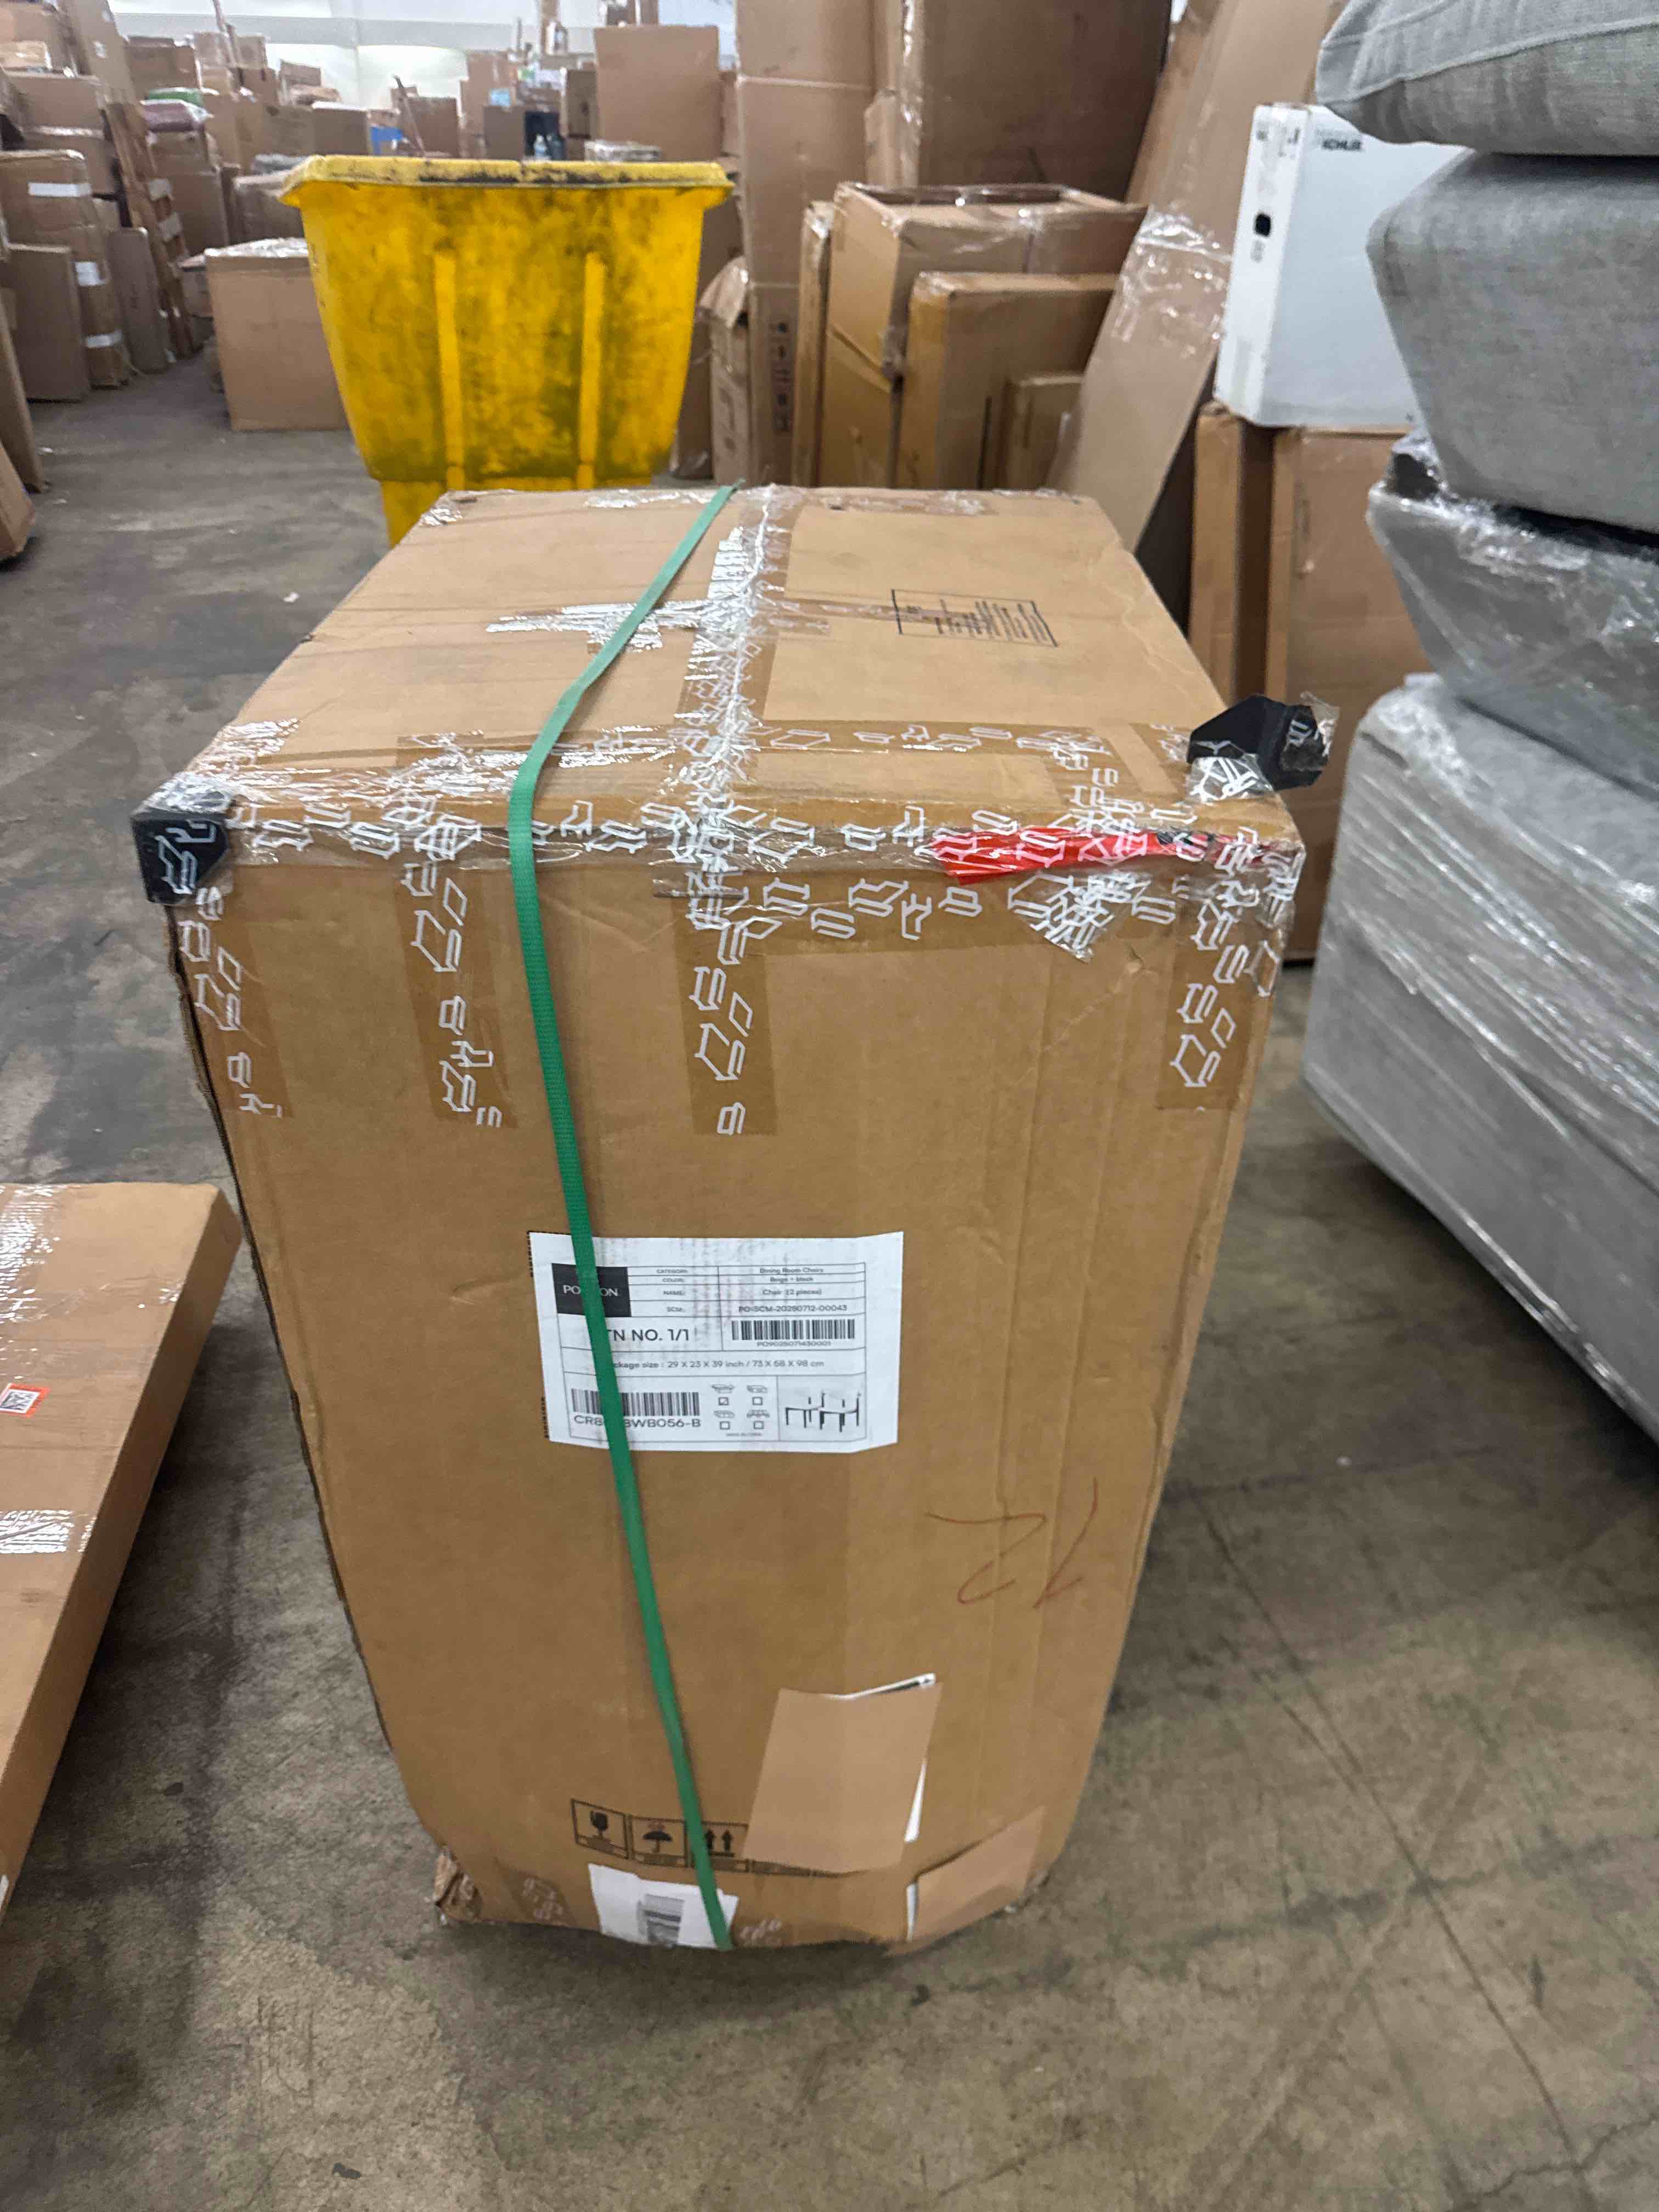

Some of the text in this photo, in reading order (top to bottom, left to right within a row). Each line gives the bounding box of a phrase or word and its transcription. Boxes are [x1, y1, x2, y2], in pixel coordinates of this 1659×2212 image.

[563, 1284, 619, 1297] POON
[631, 1329, 663, 1341] NO.
[668, 1329, 689, 1341] 1/1
[614, 1361, 640, 1370] ckage
